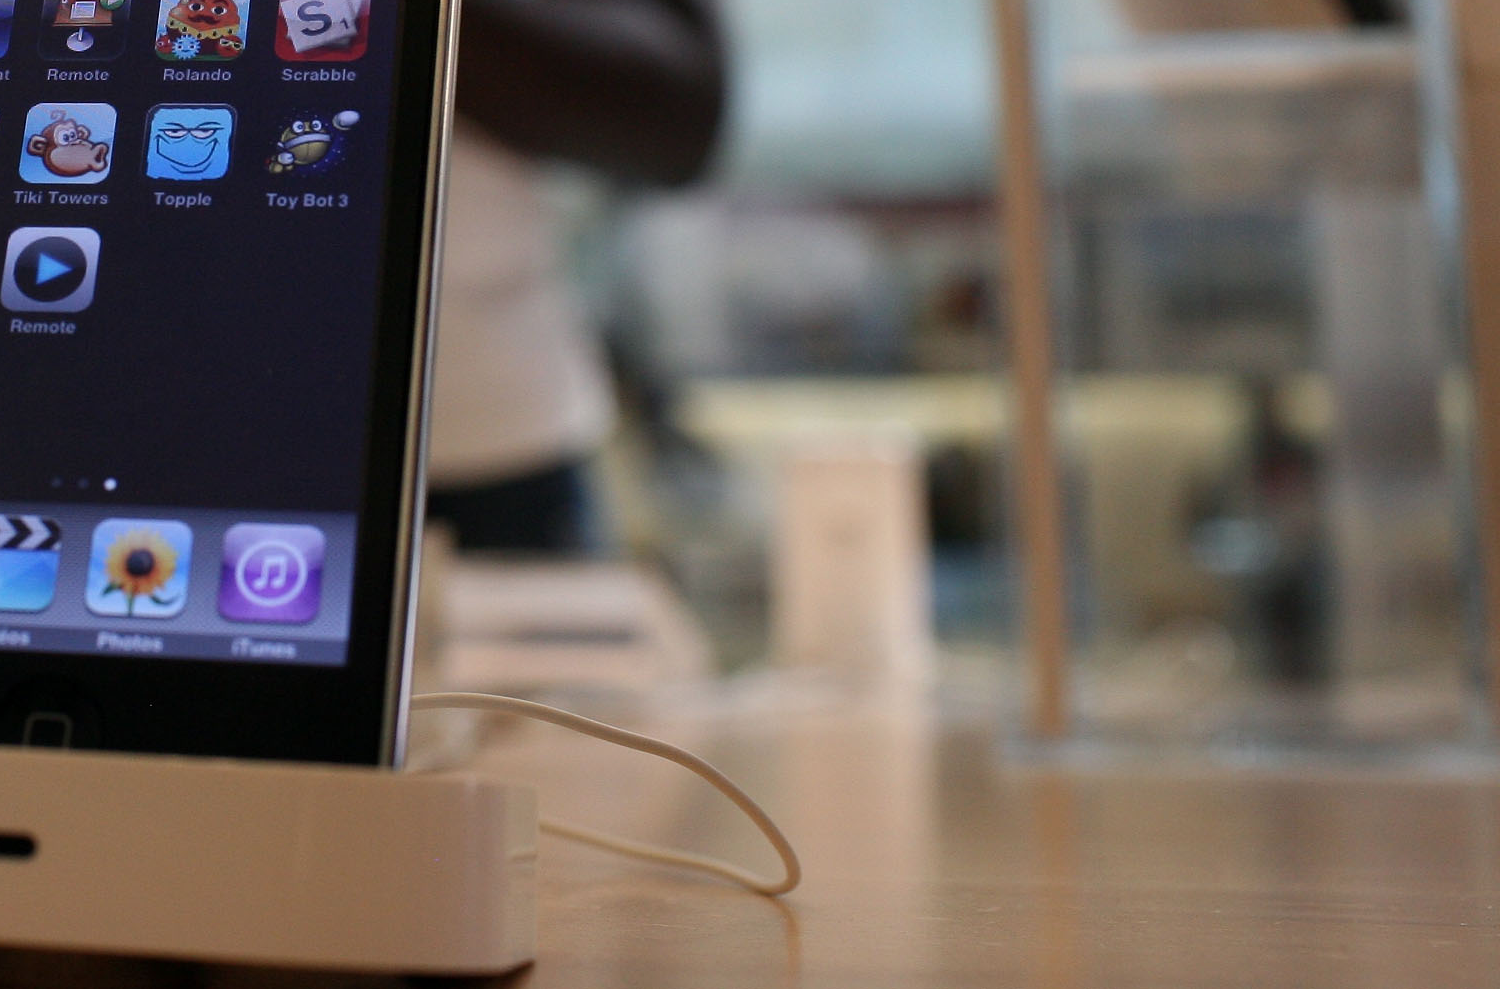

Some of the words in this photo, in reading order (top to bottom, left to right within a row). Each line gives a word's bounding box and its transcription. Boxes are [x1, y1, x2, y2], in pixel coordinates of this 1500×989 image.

[47, 68, 110, 82] Remote
[163, 68, 232, 82] Rolando
[281, 68, 357, 82] Scrabble
[13, 190, 43, 205] Tiki
[49, 191, 109, 205] Towers
[154, 192, 212, 209] Topple
[266, 193, 299, 210] Toy
[303, 193, 333, 208] Bot
[338, 194, 349, 208] 3
[10, 318, 77, 334] Remote
[96, 630, 164, 653] Photos
[231, 636, 296, 659] iTunes
